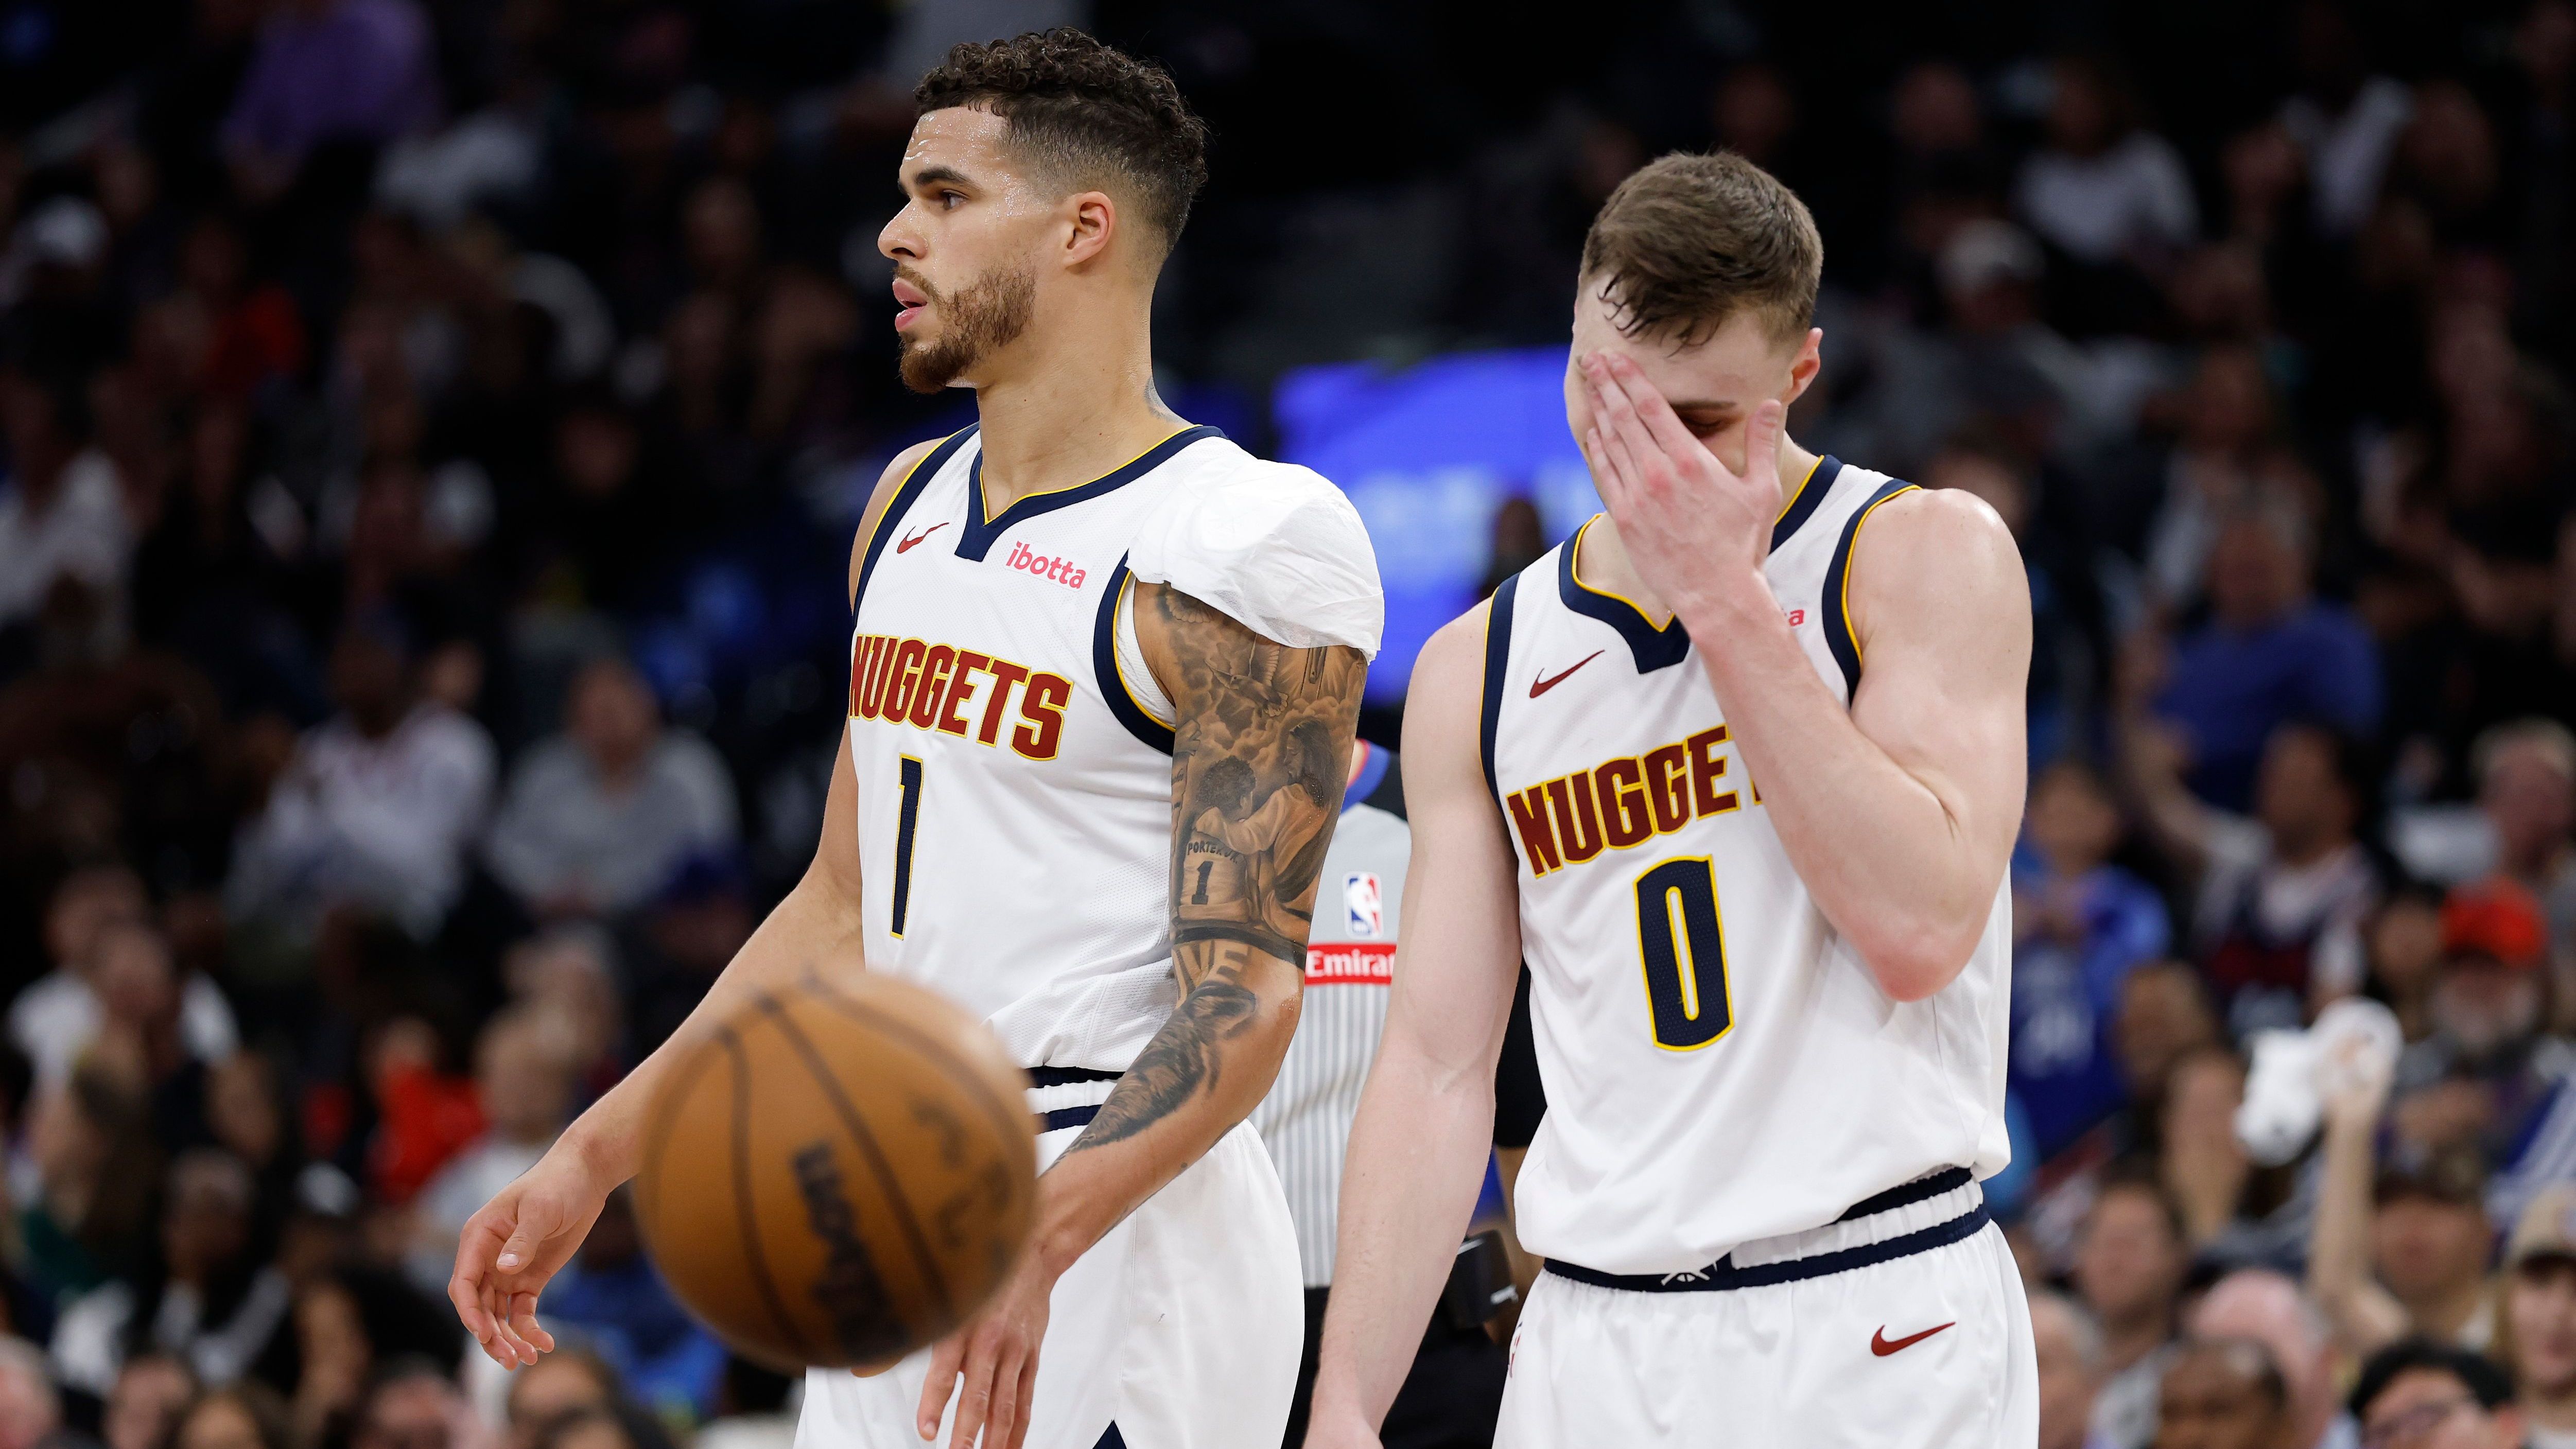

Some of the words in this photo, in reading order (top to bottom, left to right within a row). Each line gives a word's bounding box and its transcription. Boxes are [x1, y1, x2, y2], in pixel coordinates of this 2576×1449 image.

[1005, 541, 1086, 588] ibotta
[849, 634, 1073, 761] NUGGETS
[890, 753, 924, 940] 1
[1506, 724, 1762, 878] NUGGE
[1192, 861, 1213, 904] 1
[1633, 854, 1734, 1051] 0
